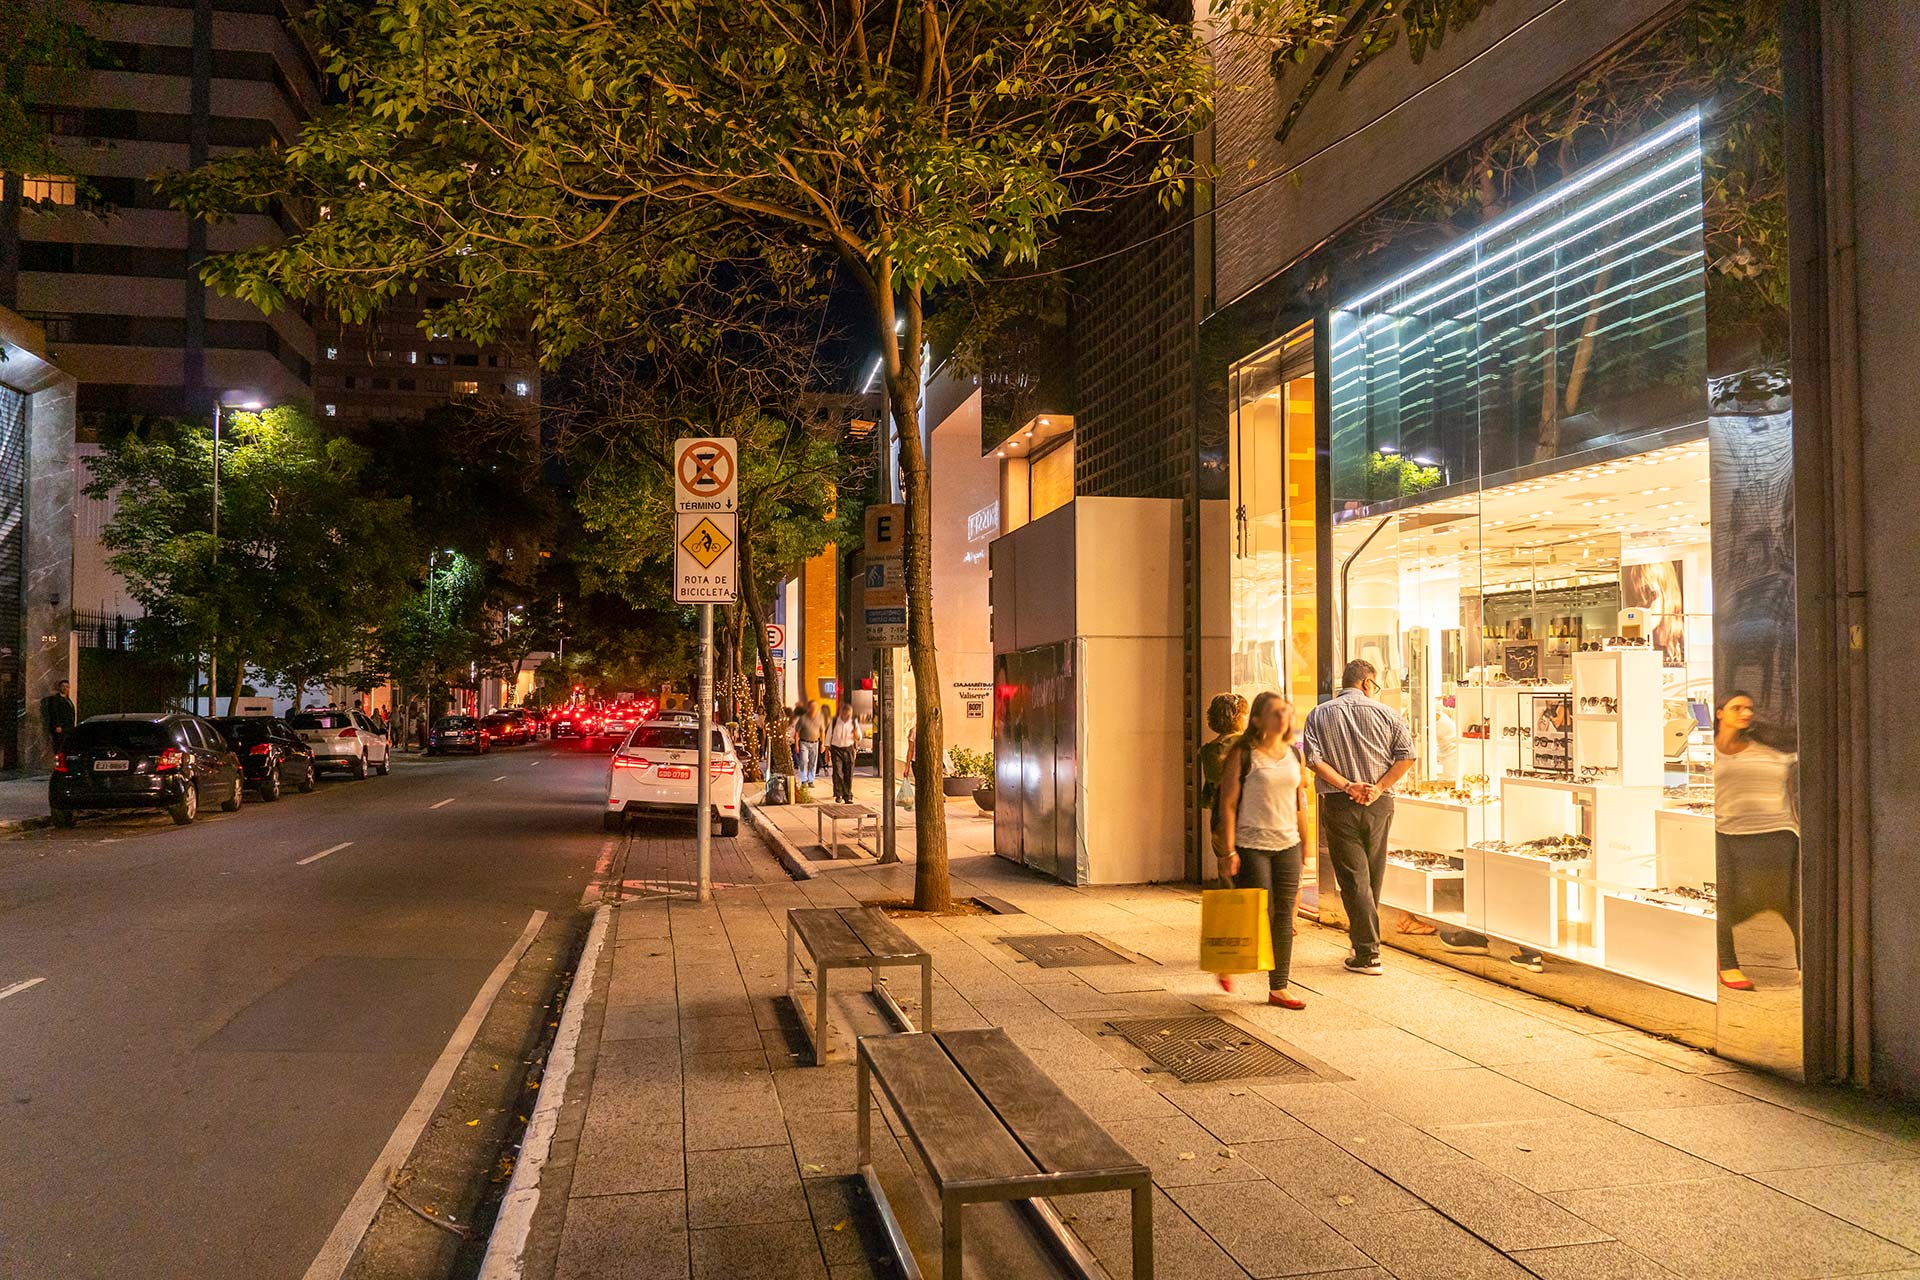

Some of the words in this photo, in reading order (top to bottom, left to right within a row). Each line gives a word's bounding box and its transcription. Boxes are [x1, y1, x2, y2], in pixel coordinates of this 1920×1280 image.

[680, 501, 721, 510] TÉRMINO
[878, 516, 891, 542] E
[684, 576, 709, 584] ROTA
[715, 576, 727, 584] DE
[680, 588, 730, 596] BICICLETA
